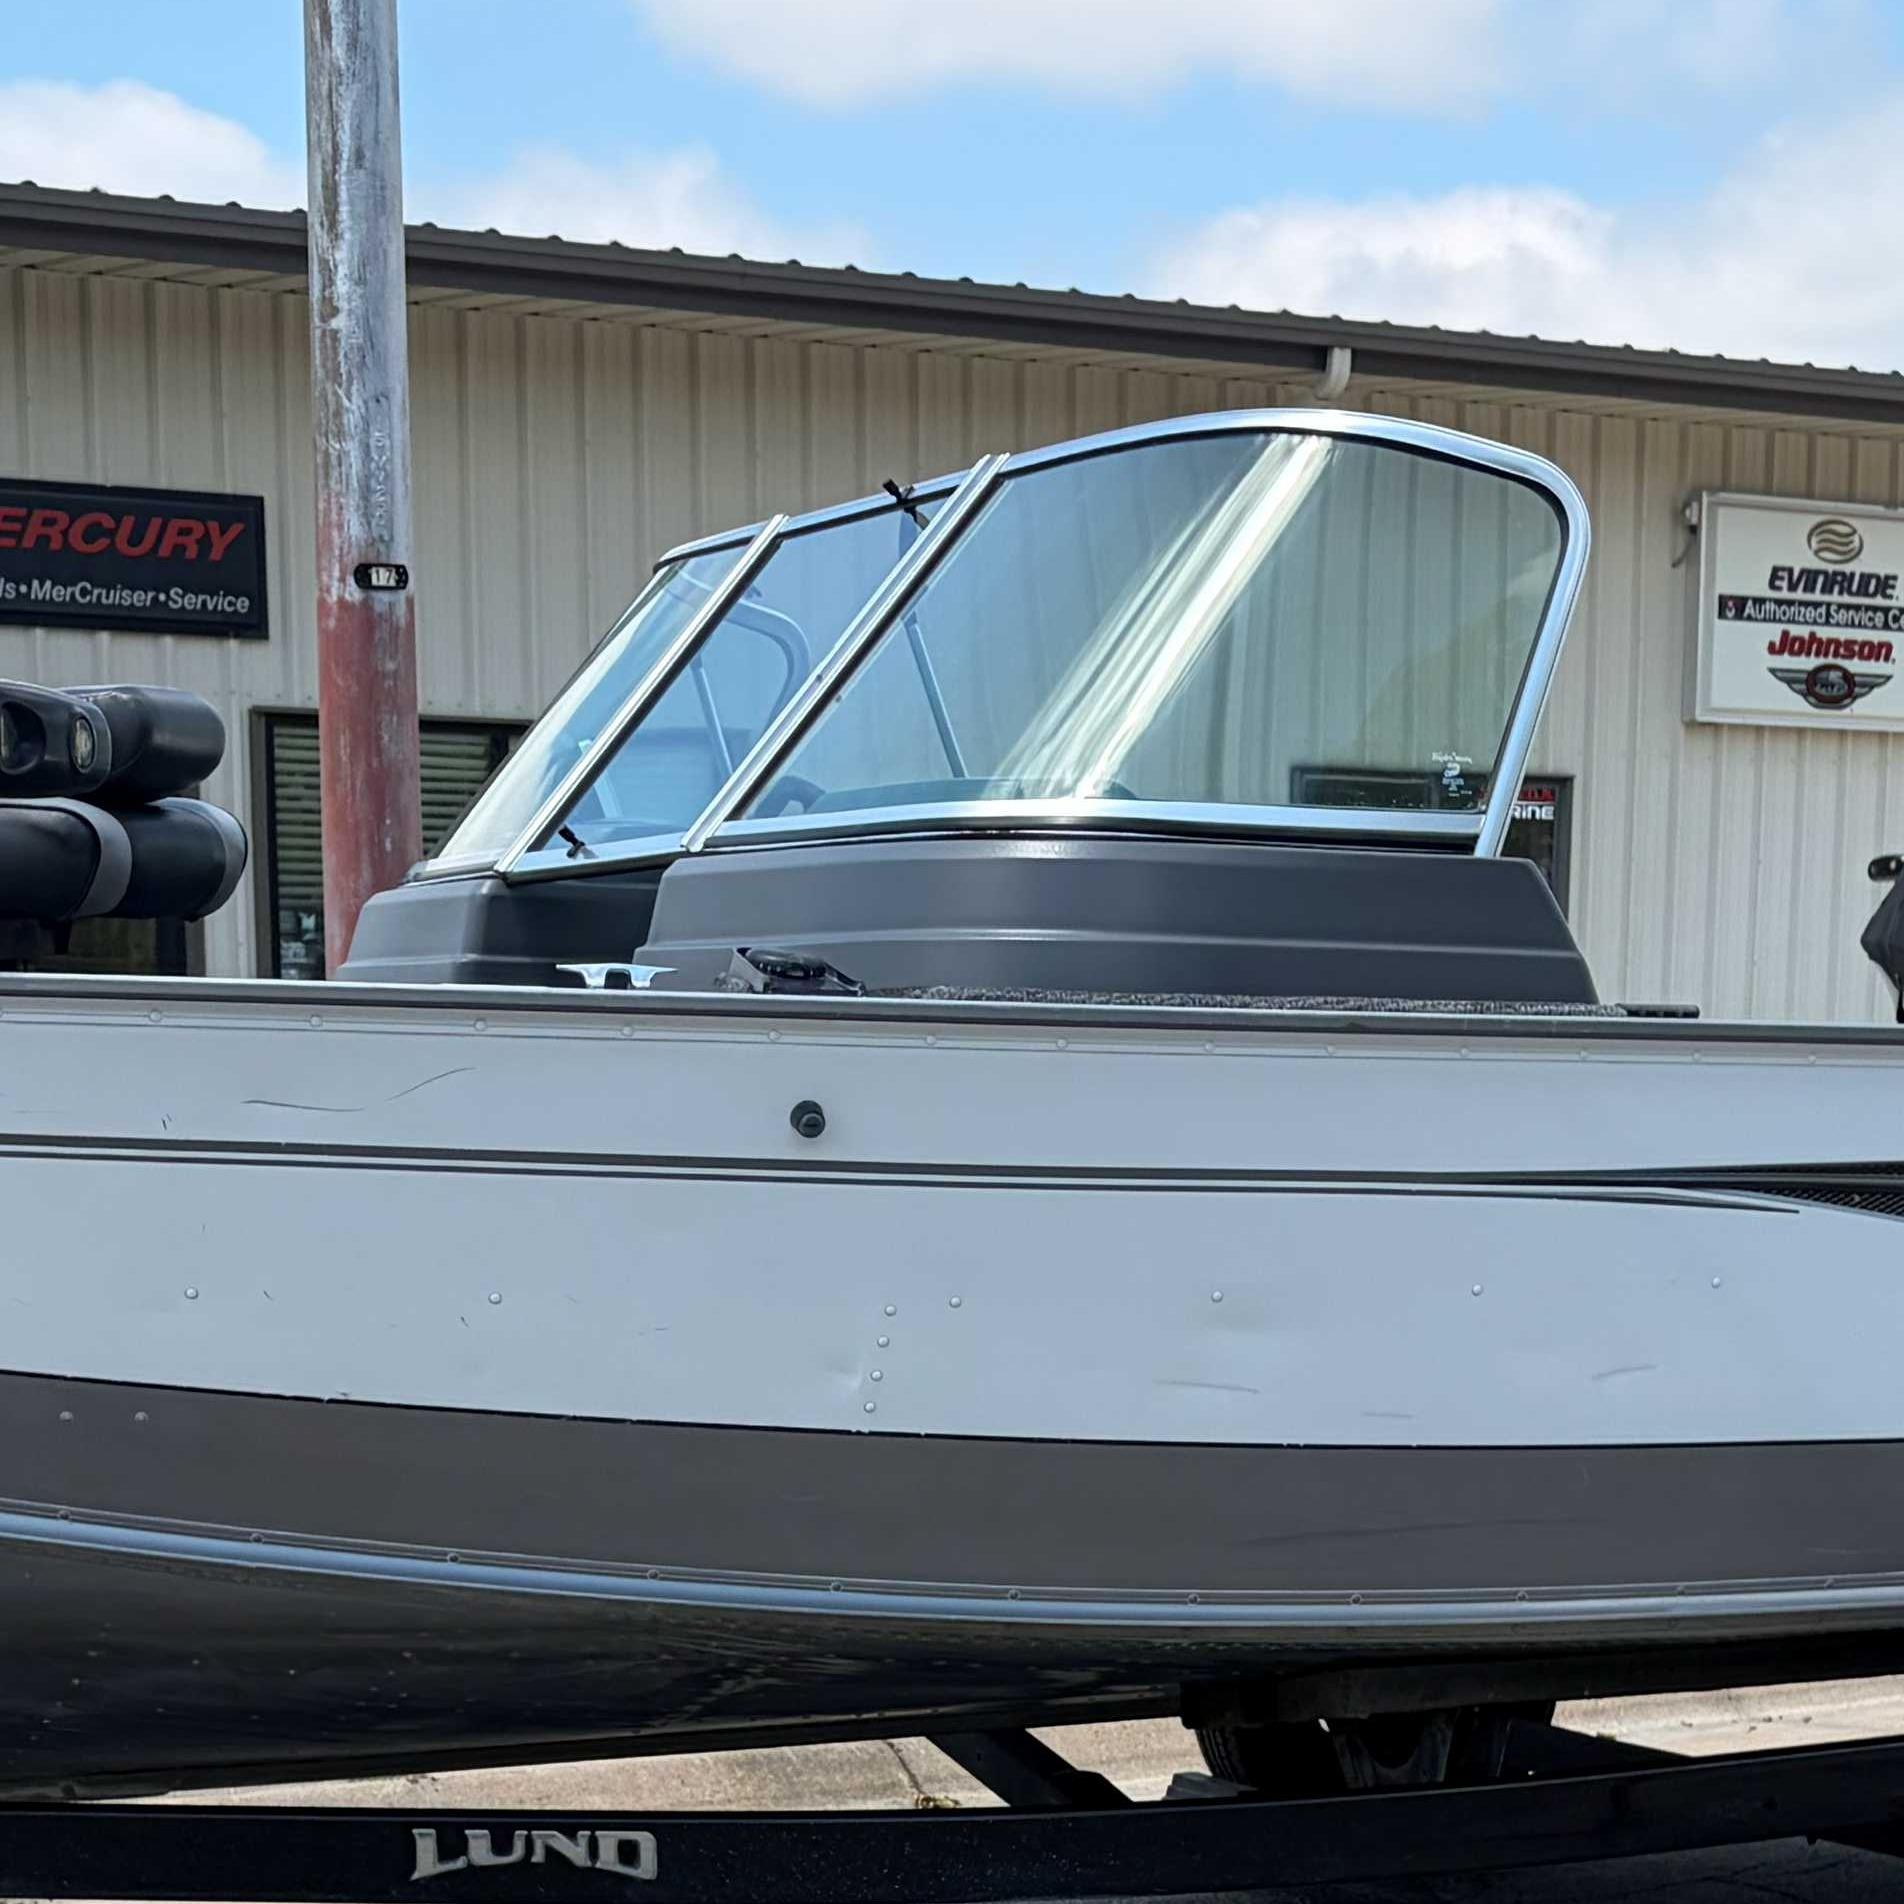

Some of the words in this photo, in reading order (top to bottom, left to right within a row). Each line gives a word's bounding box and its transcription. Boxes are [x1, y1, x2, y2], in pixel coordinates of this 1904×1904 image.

[30, 579, 155, 608] MerCruiser
[167, 587, 251, 614] Service
[1768, 564, 1899, 600] EVINRUDE
[1743, 598, 1826, 624] Authorized
[1829, 603, 1885, 627] Service
[1767, 629, 1895, 664] Johnson
[408, 1827, 658, 1881] LUND
